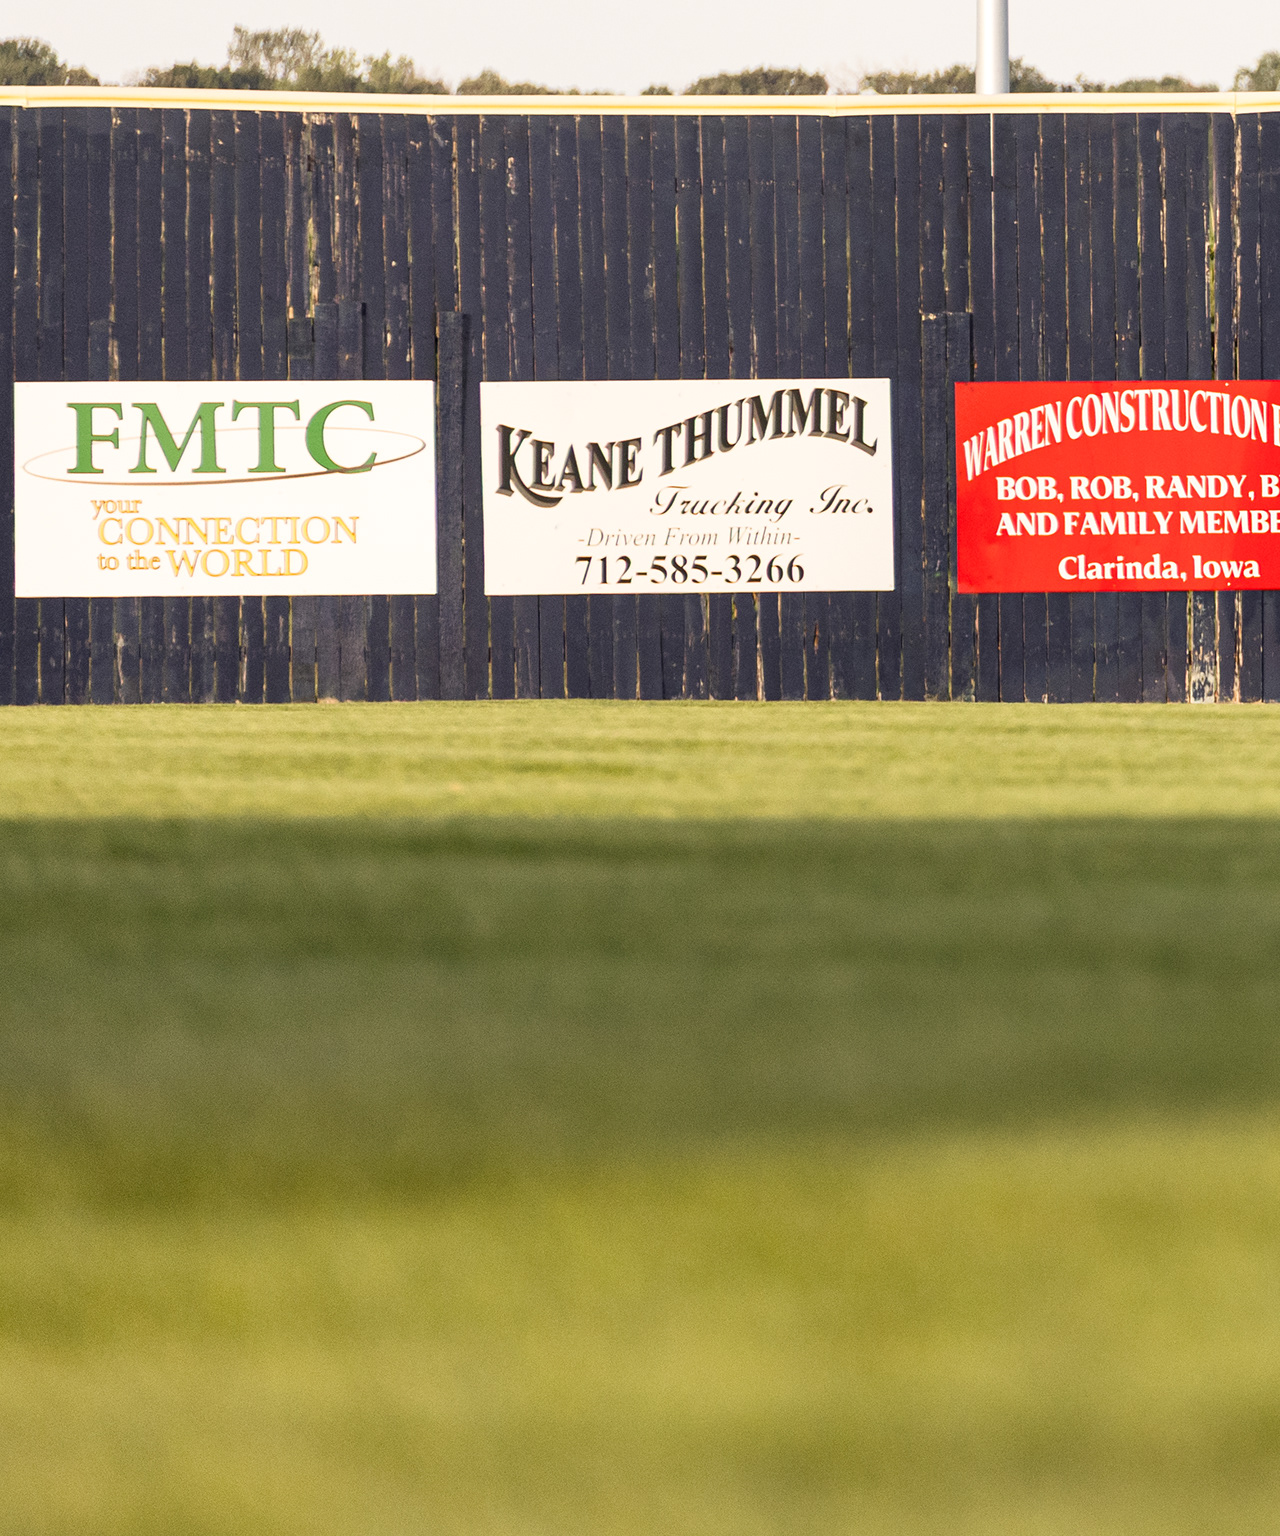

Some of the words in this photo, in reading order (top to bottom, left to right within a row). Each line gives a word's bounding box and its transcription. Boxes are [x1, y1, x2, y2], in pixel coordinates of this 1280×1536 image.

[66, 399, 378, 474] FMTC
[494, 424, 643, 508] KEANE
[652, 387, 878, 478] THUMMEL
[962, 400, 1062, 482] WARREN
[1065, 388, 1268, 444] CONSTRUCTION
[649, 485, 793, 523] Trucking
[809, 484, 874, 514] Inc.
[996, 476, 1064, 503] BOB,
[1069, 476, 1139, 502] ROB,
[90, 499, 142, 520] your
[995, 513, 1058, 536] AND
[1063, 511, 1173, 536] FAMILY
[97, 516, 360, 545] CONNECTION
[577, 527, 656, 547] -Driven
[664, 527, 718, 546] From
[727, 526, 801, 547] Within-
[97, 552, 119, 571] to
[126, 550, 161, 571] the
[165, 548, 309, 578] WORLD
[575, 554, 805, 585] 712-585-3266
[1057, 553, 1187, 582] Clarinda,
[1192, 555, 1261, 579] Iowa
